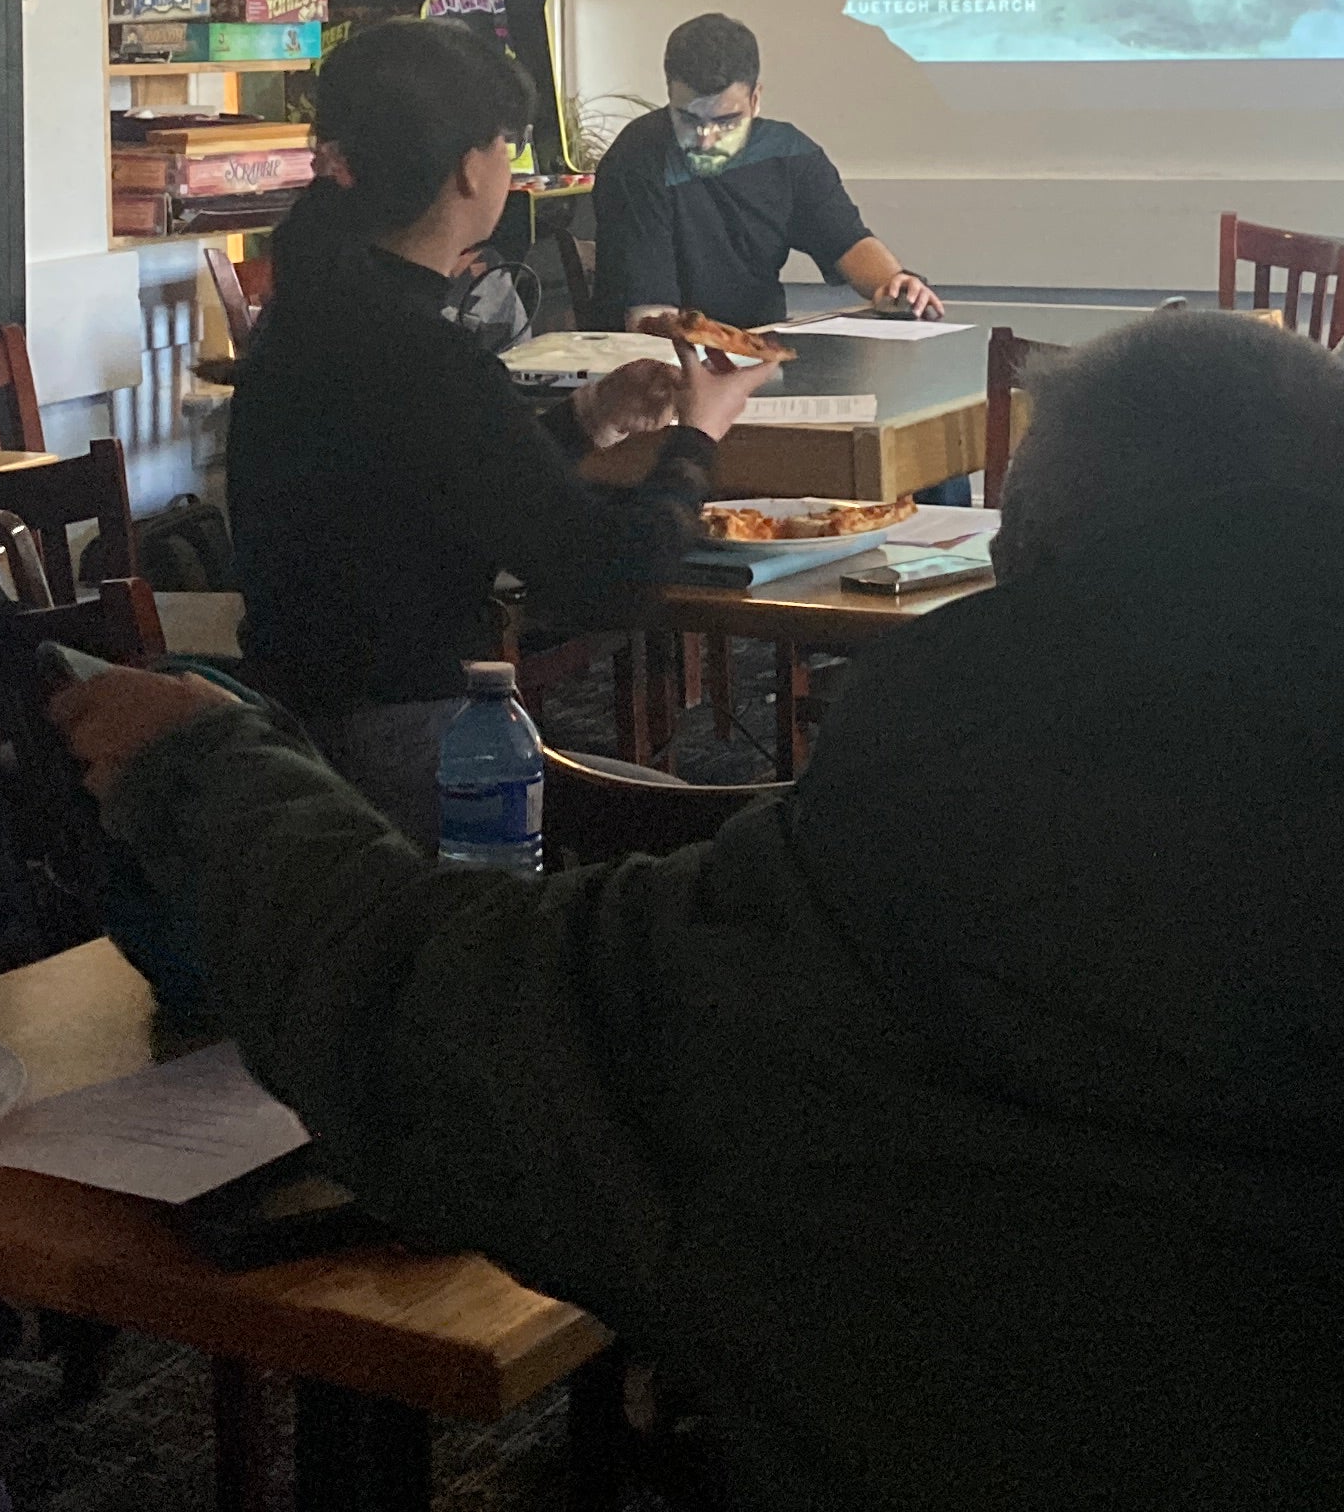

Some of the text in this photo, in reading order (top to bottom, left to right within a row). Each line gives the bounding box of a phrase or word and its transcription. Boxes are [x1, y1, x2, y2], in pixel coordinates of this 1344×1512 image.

[846, 0, 1037, 15] LUETECH RESEARCH
[225, 159, 282, 184] SCRABBLE
